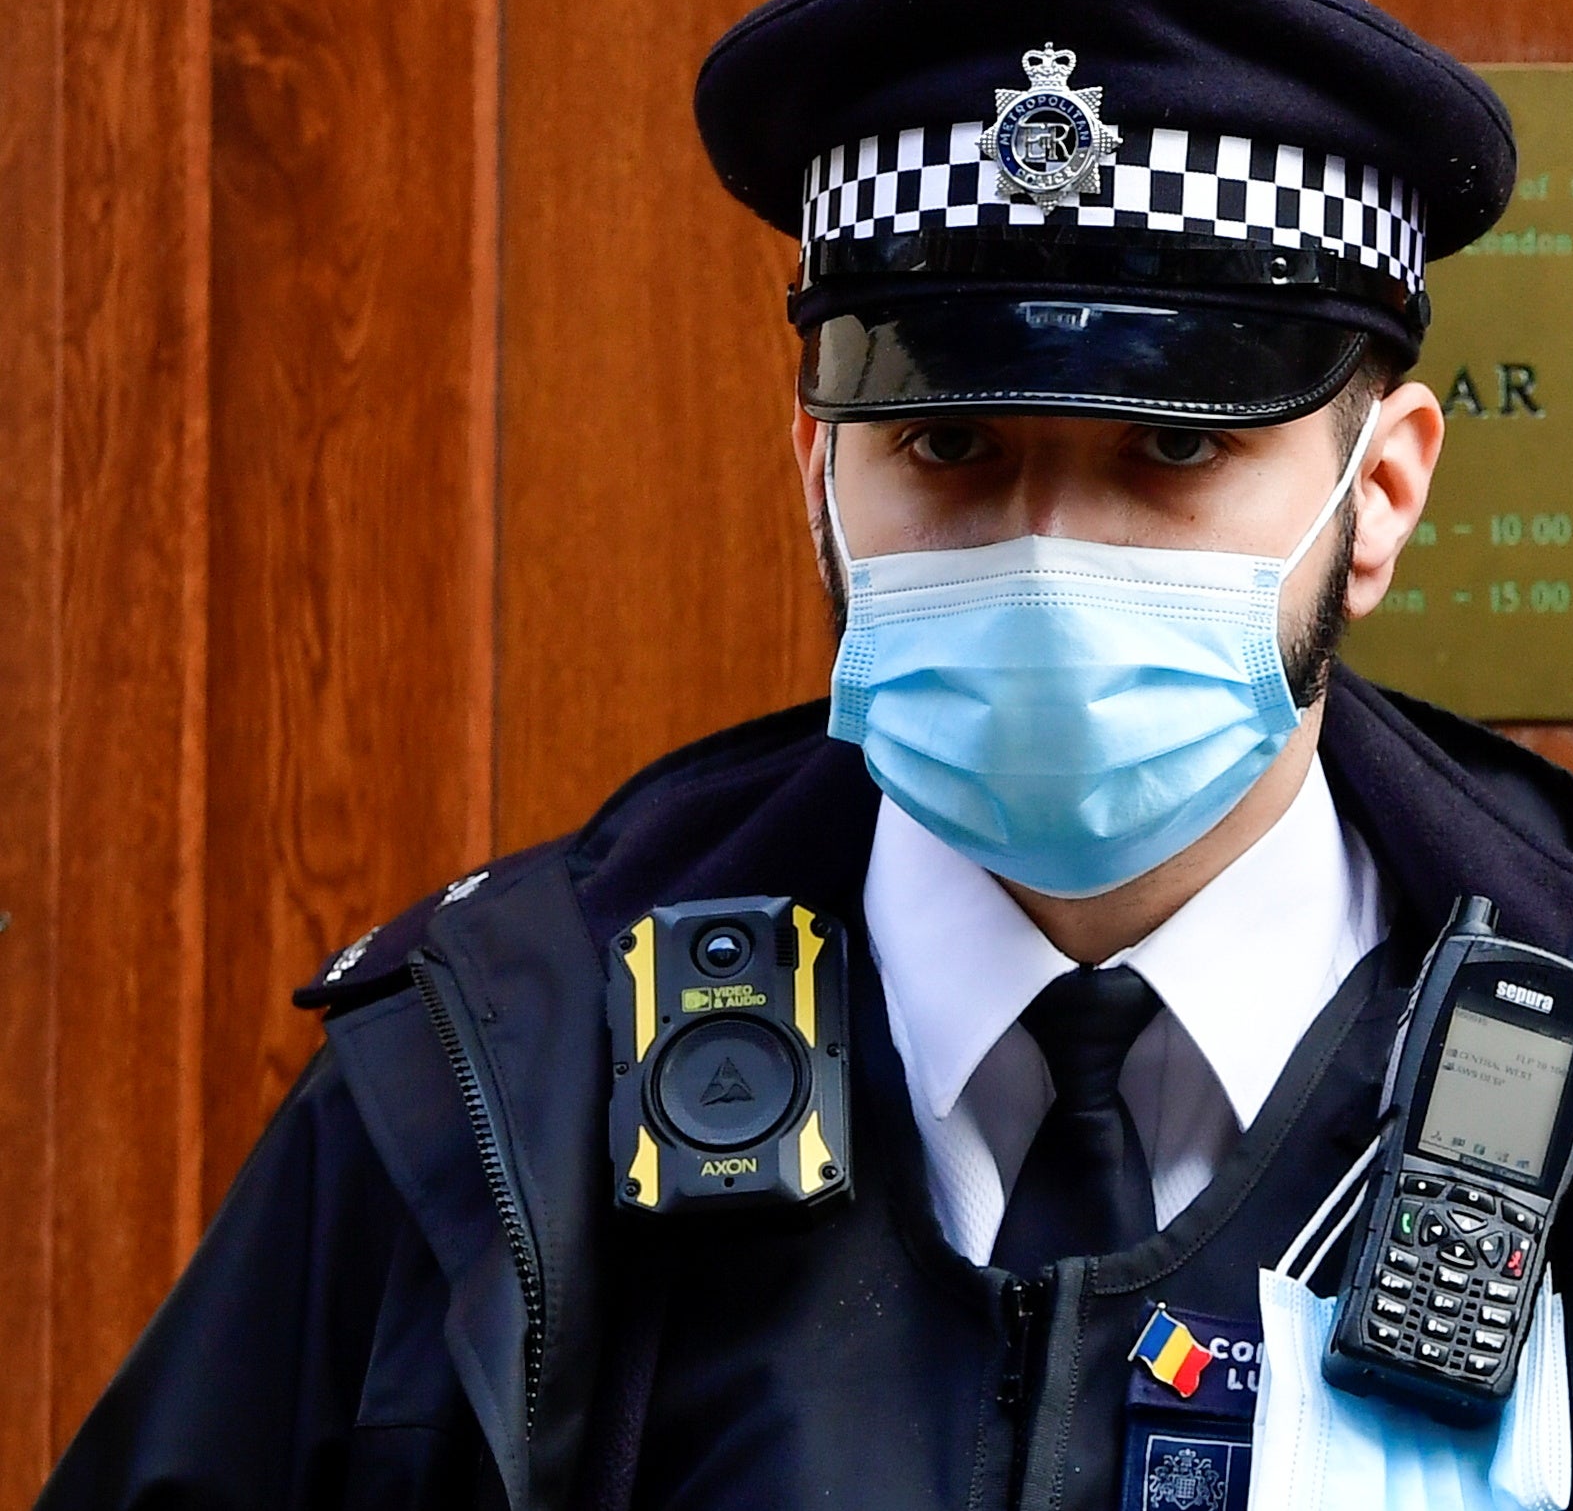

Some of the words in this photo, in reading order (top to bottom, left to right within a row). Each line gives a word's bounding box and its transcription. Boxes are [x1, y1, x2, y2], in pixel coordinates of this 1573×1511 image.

[999, 95, 1090, 146] METROPOLITAN
[713, 985, 753, 998] VIDEO
[725, 994, 766, 1008] AUDIO
[1496, 980, 1554, 1011] sepura
[701, 1158, 758, 1177] AXON
